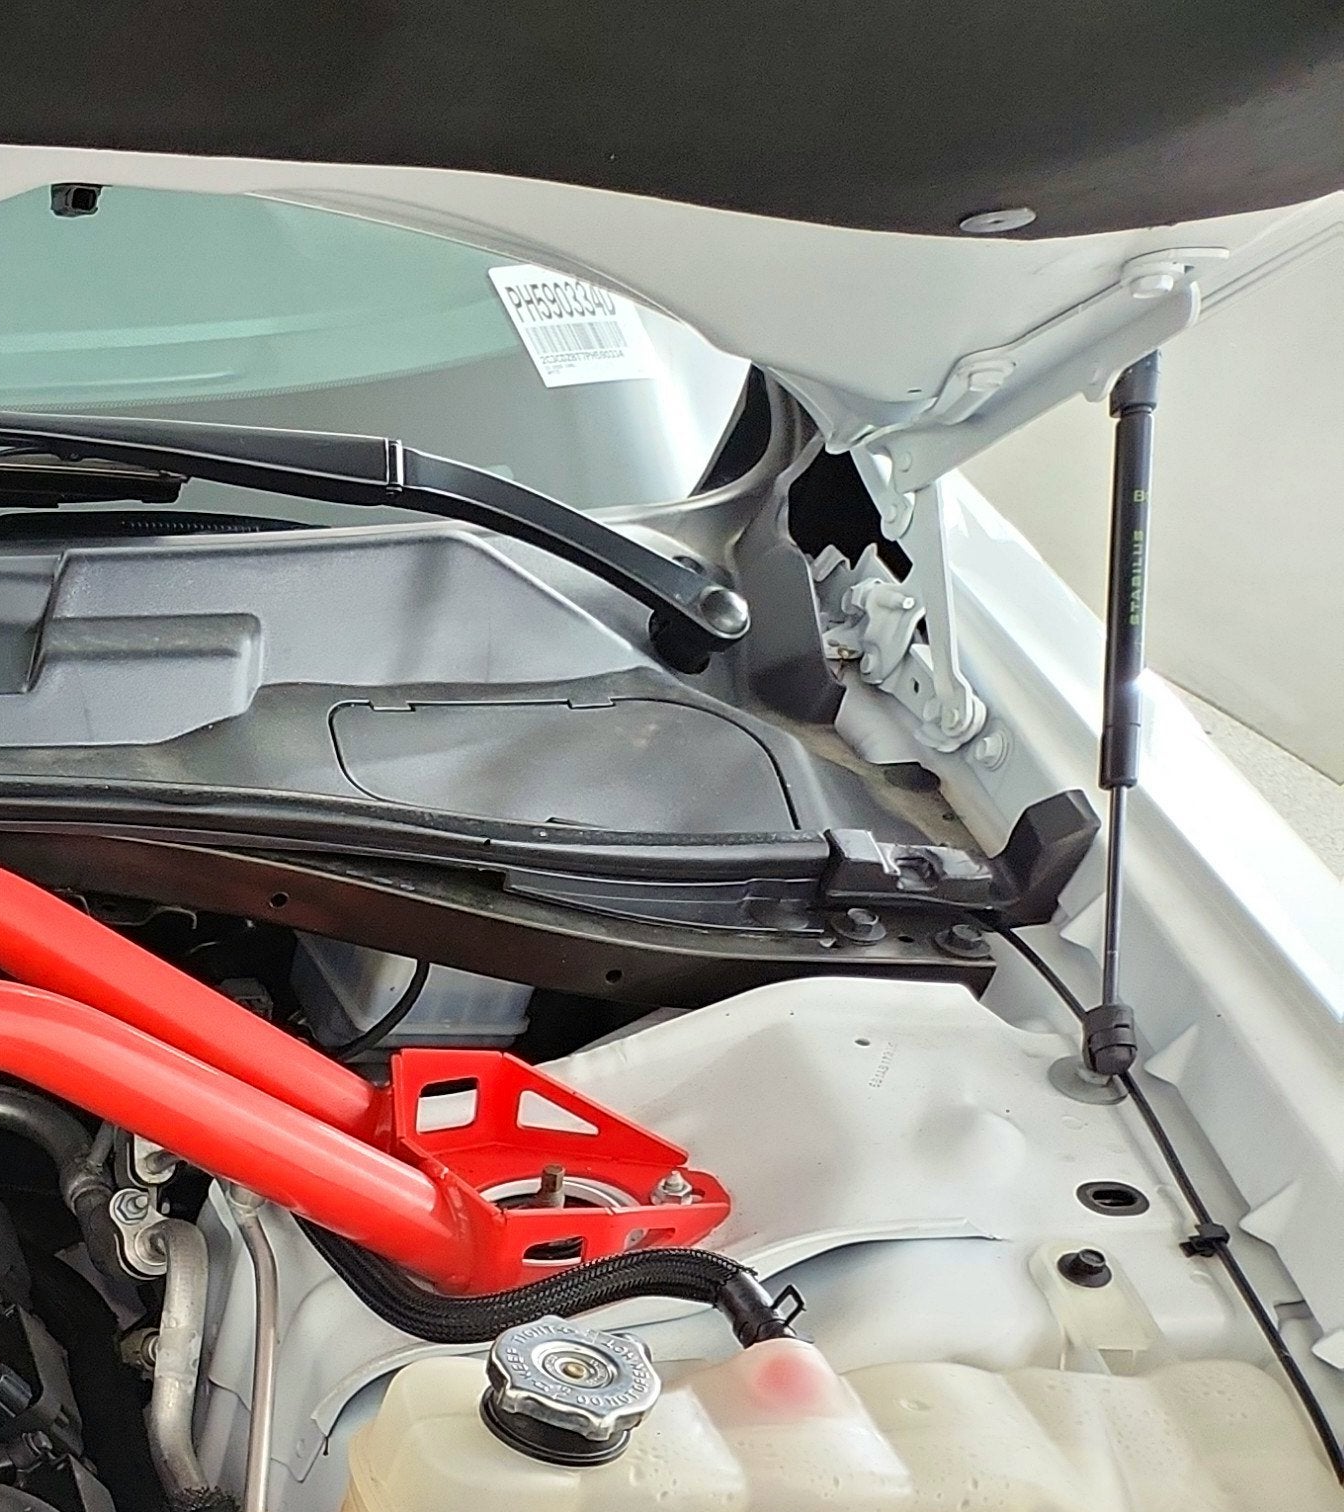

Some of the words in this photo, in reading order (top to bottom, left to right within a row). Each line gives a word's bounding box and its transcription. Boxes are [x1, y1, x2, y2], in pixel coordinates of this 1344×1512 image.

[1129, 530, 1144, 626] STABILUS
[513, 1325, 556, 1344] TIGHT
[576, 1395, 603, 1407] DO
[605, 1390, 640, 1407] NOT
